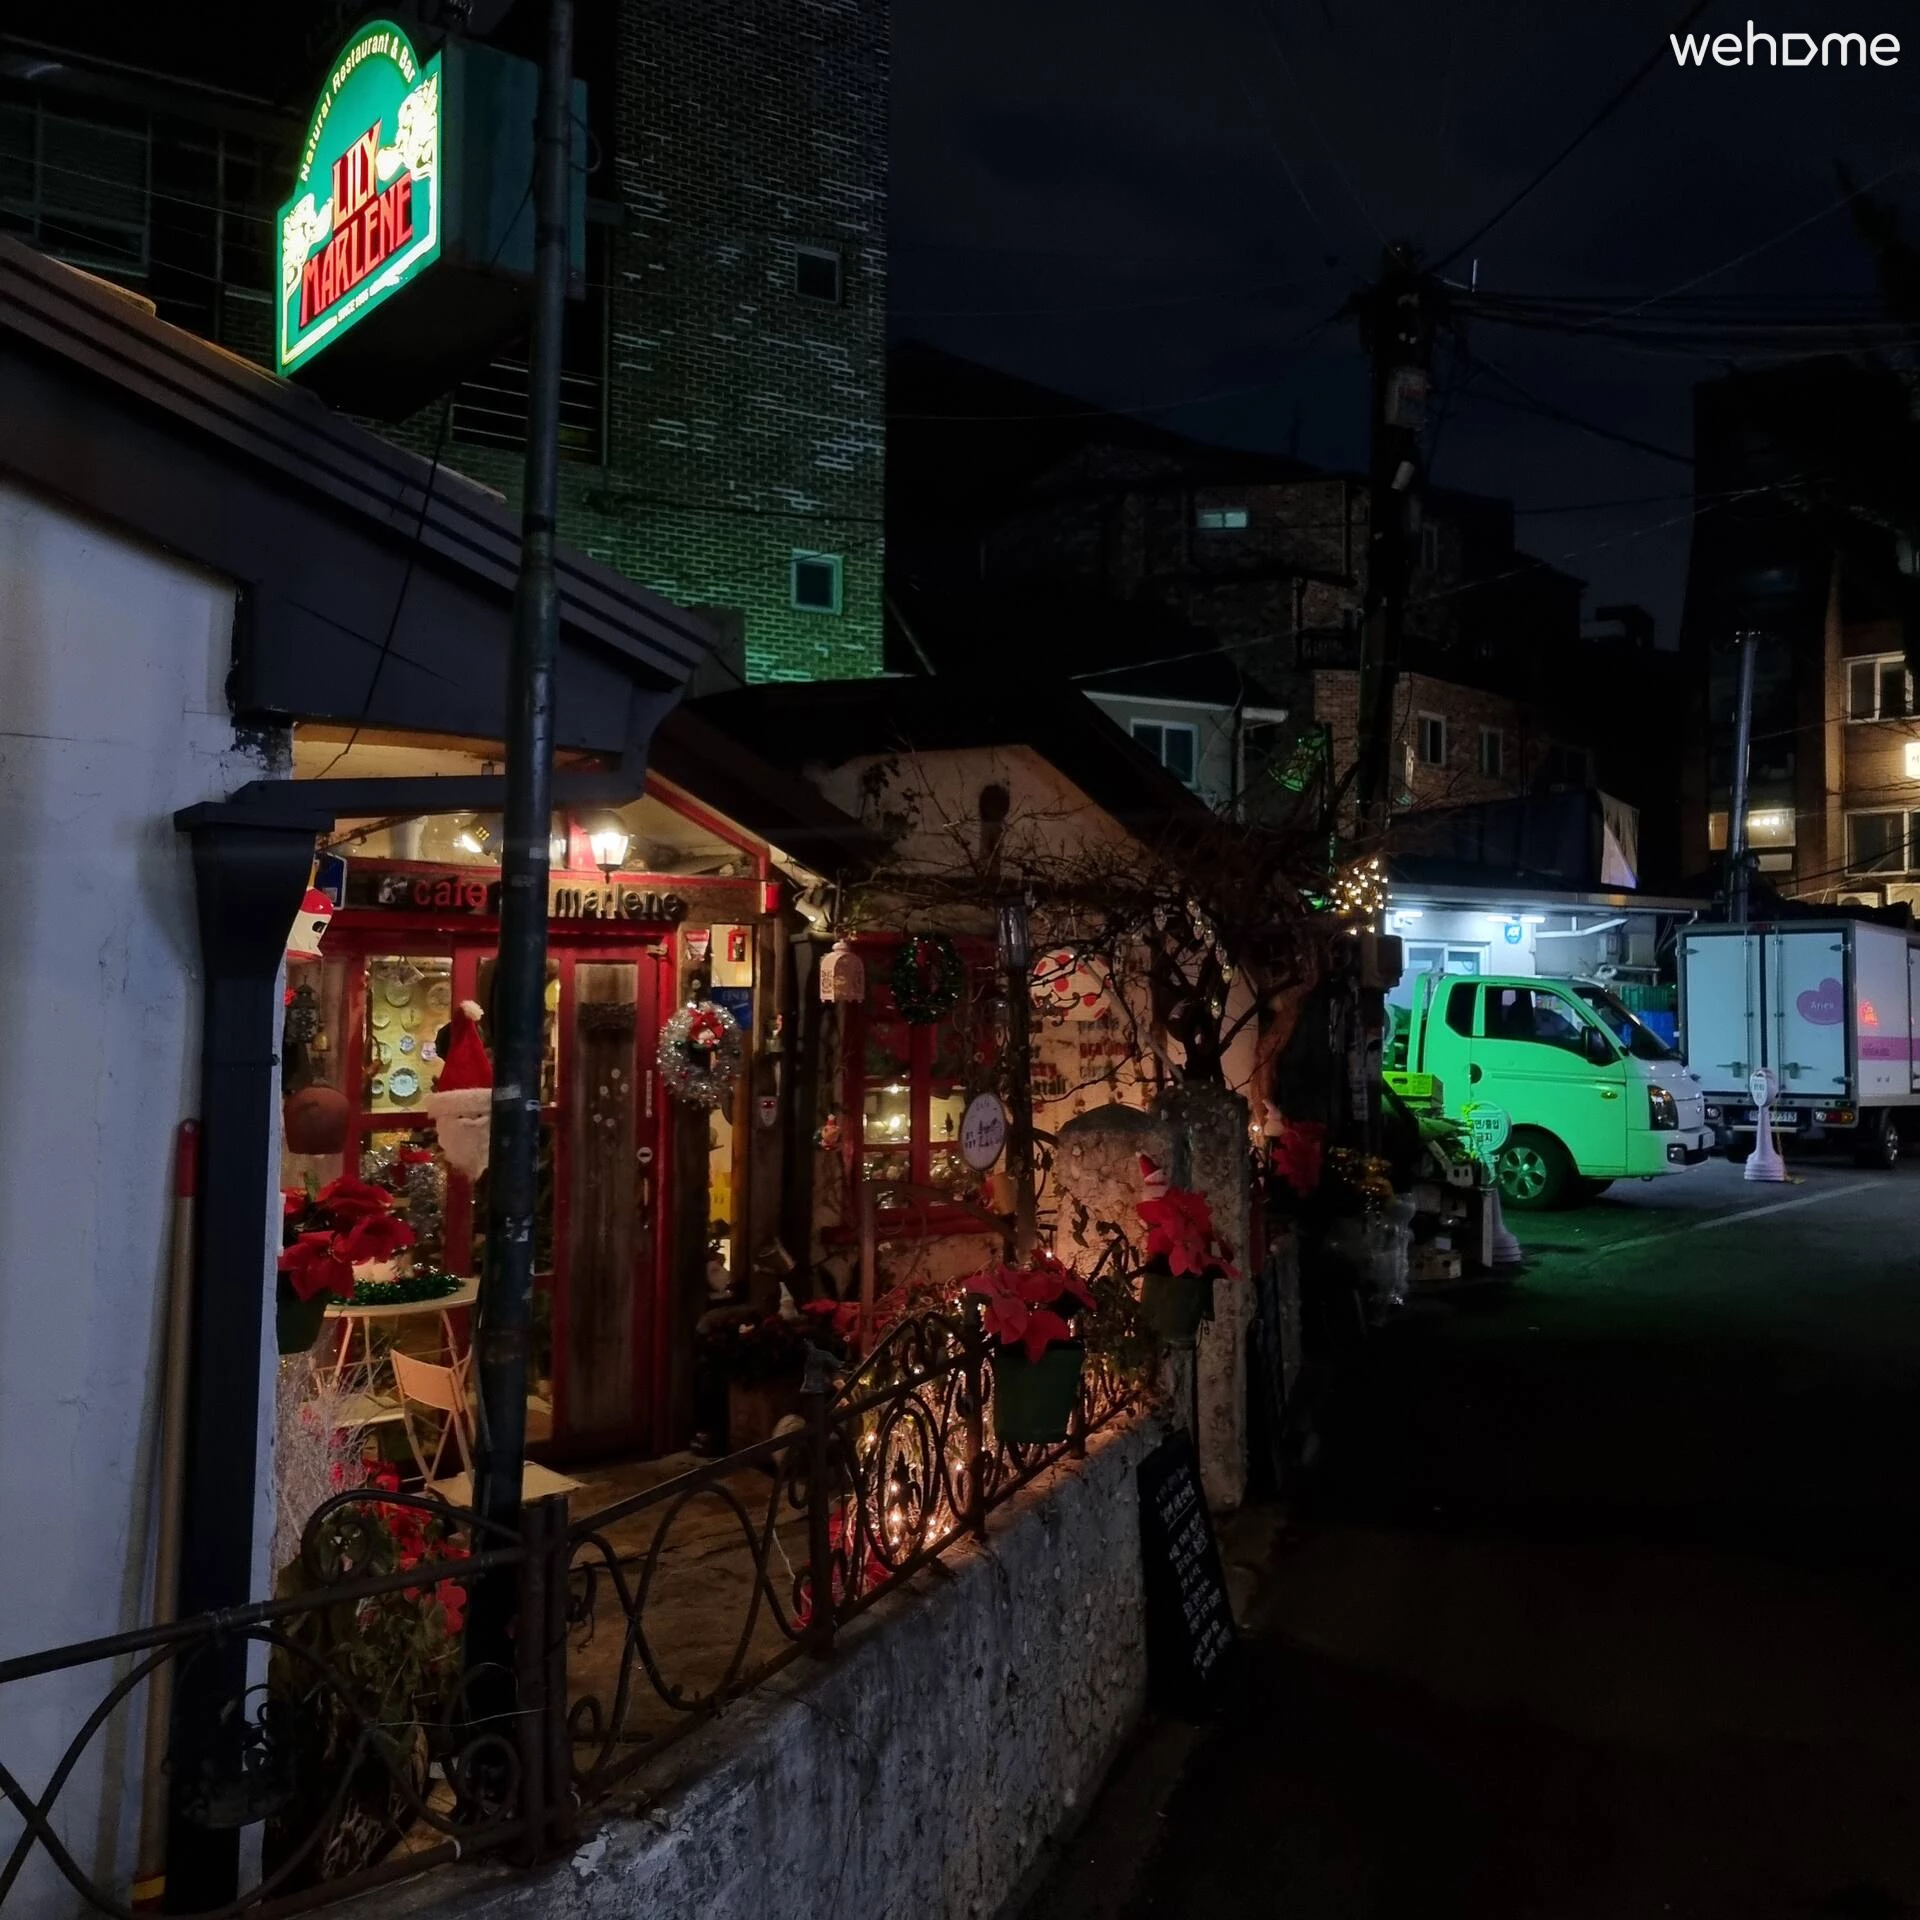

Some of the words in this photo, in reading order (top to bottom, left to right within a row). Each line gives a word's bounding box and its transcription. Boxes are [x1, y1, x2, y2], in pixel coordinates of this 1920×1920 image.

[300, 92, 331, 182] Natural
[332, 32, 390, 94] Restaurant
[390, 36, 400, 60] &
[398, 46, 416, 83] Bar
[332, 119, 382, 231] LILY
[299, 172, 413, 328] MARLENE
[413, 875, 488, 908] cafe
[556, 883, 682, 919] marlene
